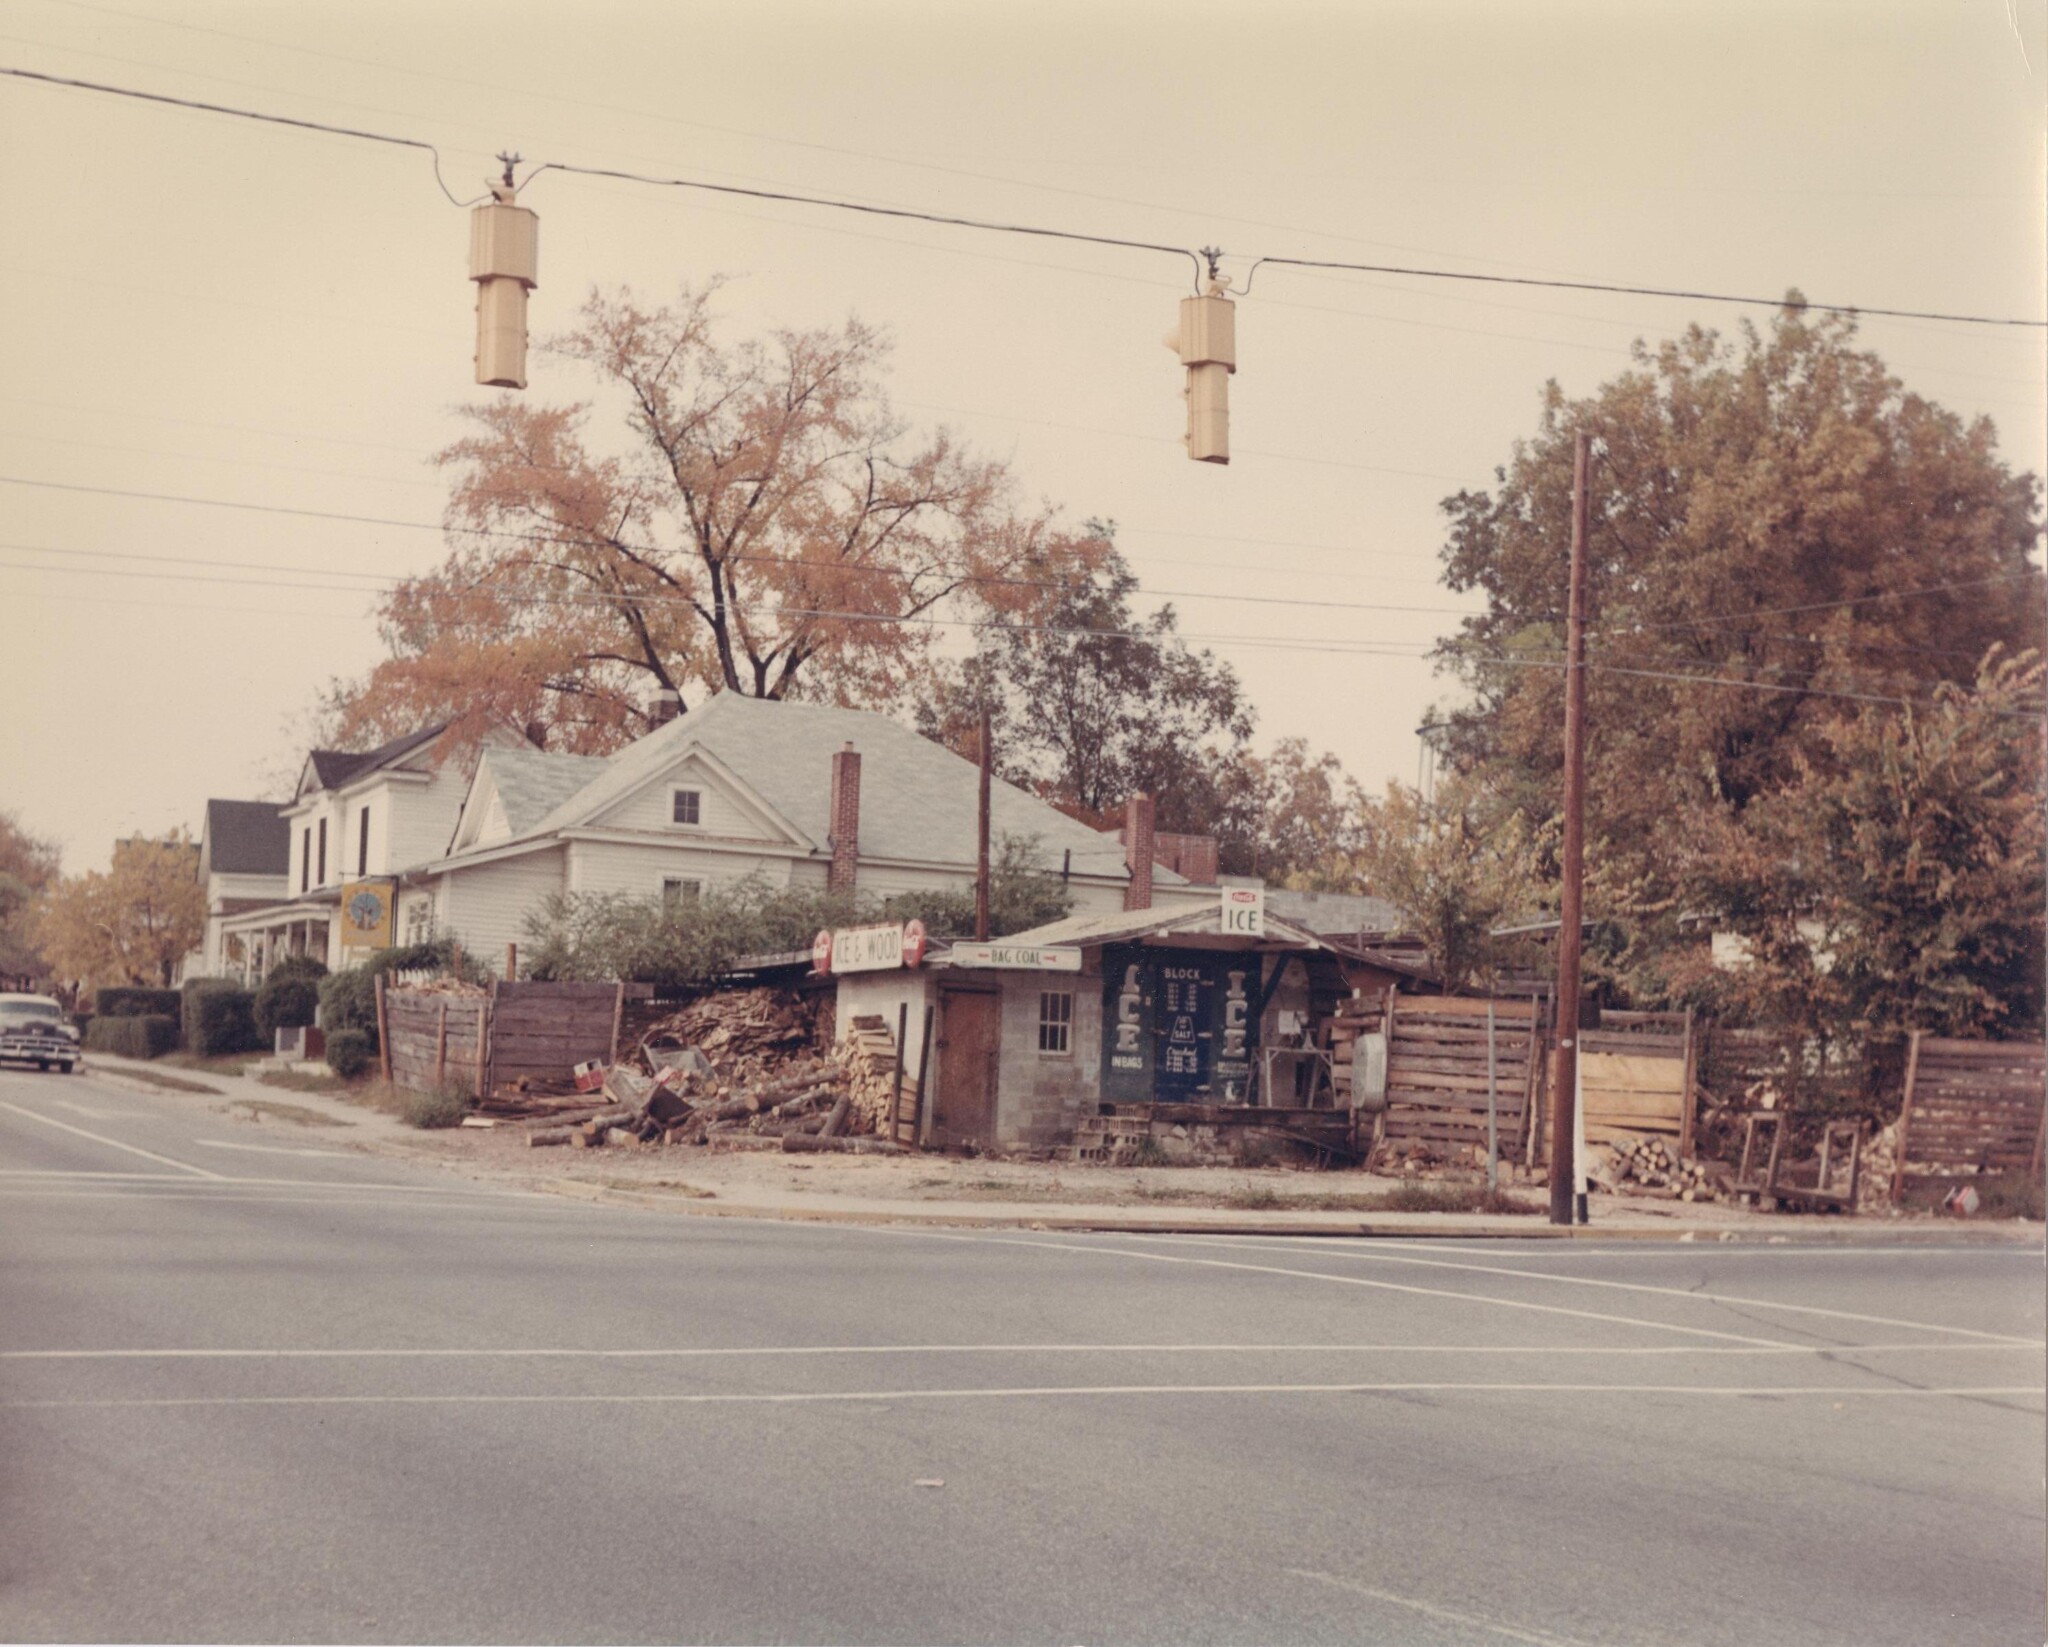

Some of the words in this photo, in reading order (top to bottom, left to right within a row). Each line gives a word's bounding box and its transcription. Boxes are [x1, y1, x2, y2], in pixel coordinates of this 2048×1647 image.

[1229, 909, 1257, 931] ICE
[835, 935, 850, 964] ICE
[867, 930, 899, 961] WOOD
[991, 949, 1012, 963] BAG
[1015, 950, 1041, 965] COAL
[1164, 967, 1200, 980] BLOCK
[1116, 964, 1141, 1052] ICE
[1222, 971, 1248, 1057] ICE
[1174, 1030, 1191, 1039] SALT
[1111, 1055, 1121, 1067] IN
[1121, 1056, 1143, 1069] BAGS
